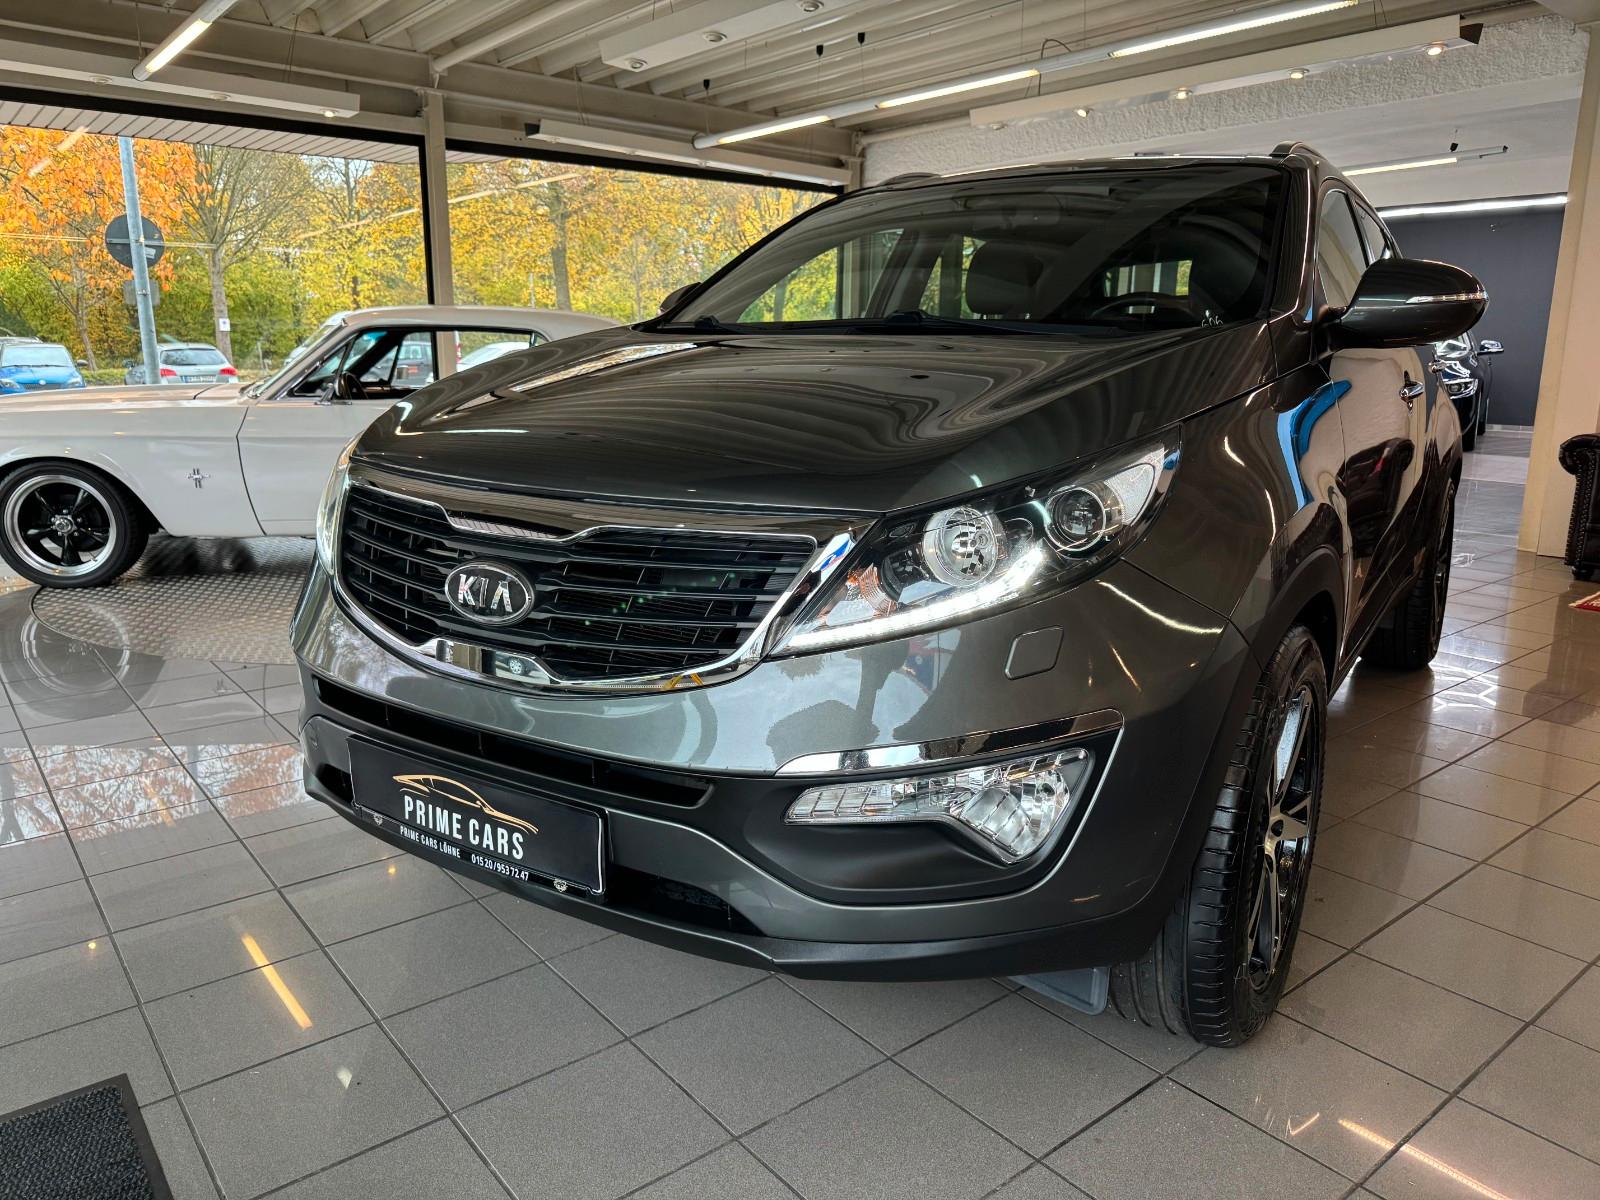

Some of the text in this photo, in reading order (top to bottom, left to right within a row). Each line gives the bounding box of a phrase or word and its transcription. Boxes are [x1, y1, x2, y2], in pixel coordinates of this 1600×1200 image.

[458, 573, 513, 613] KIA
[400, 825, 420, 843] PRIME
[420, 834, 438, 850] CARS
[404, 794, 524, 860] PRIME CARS
